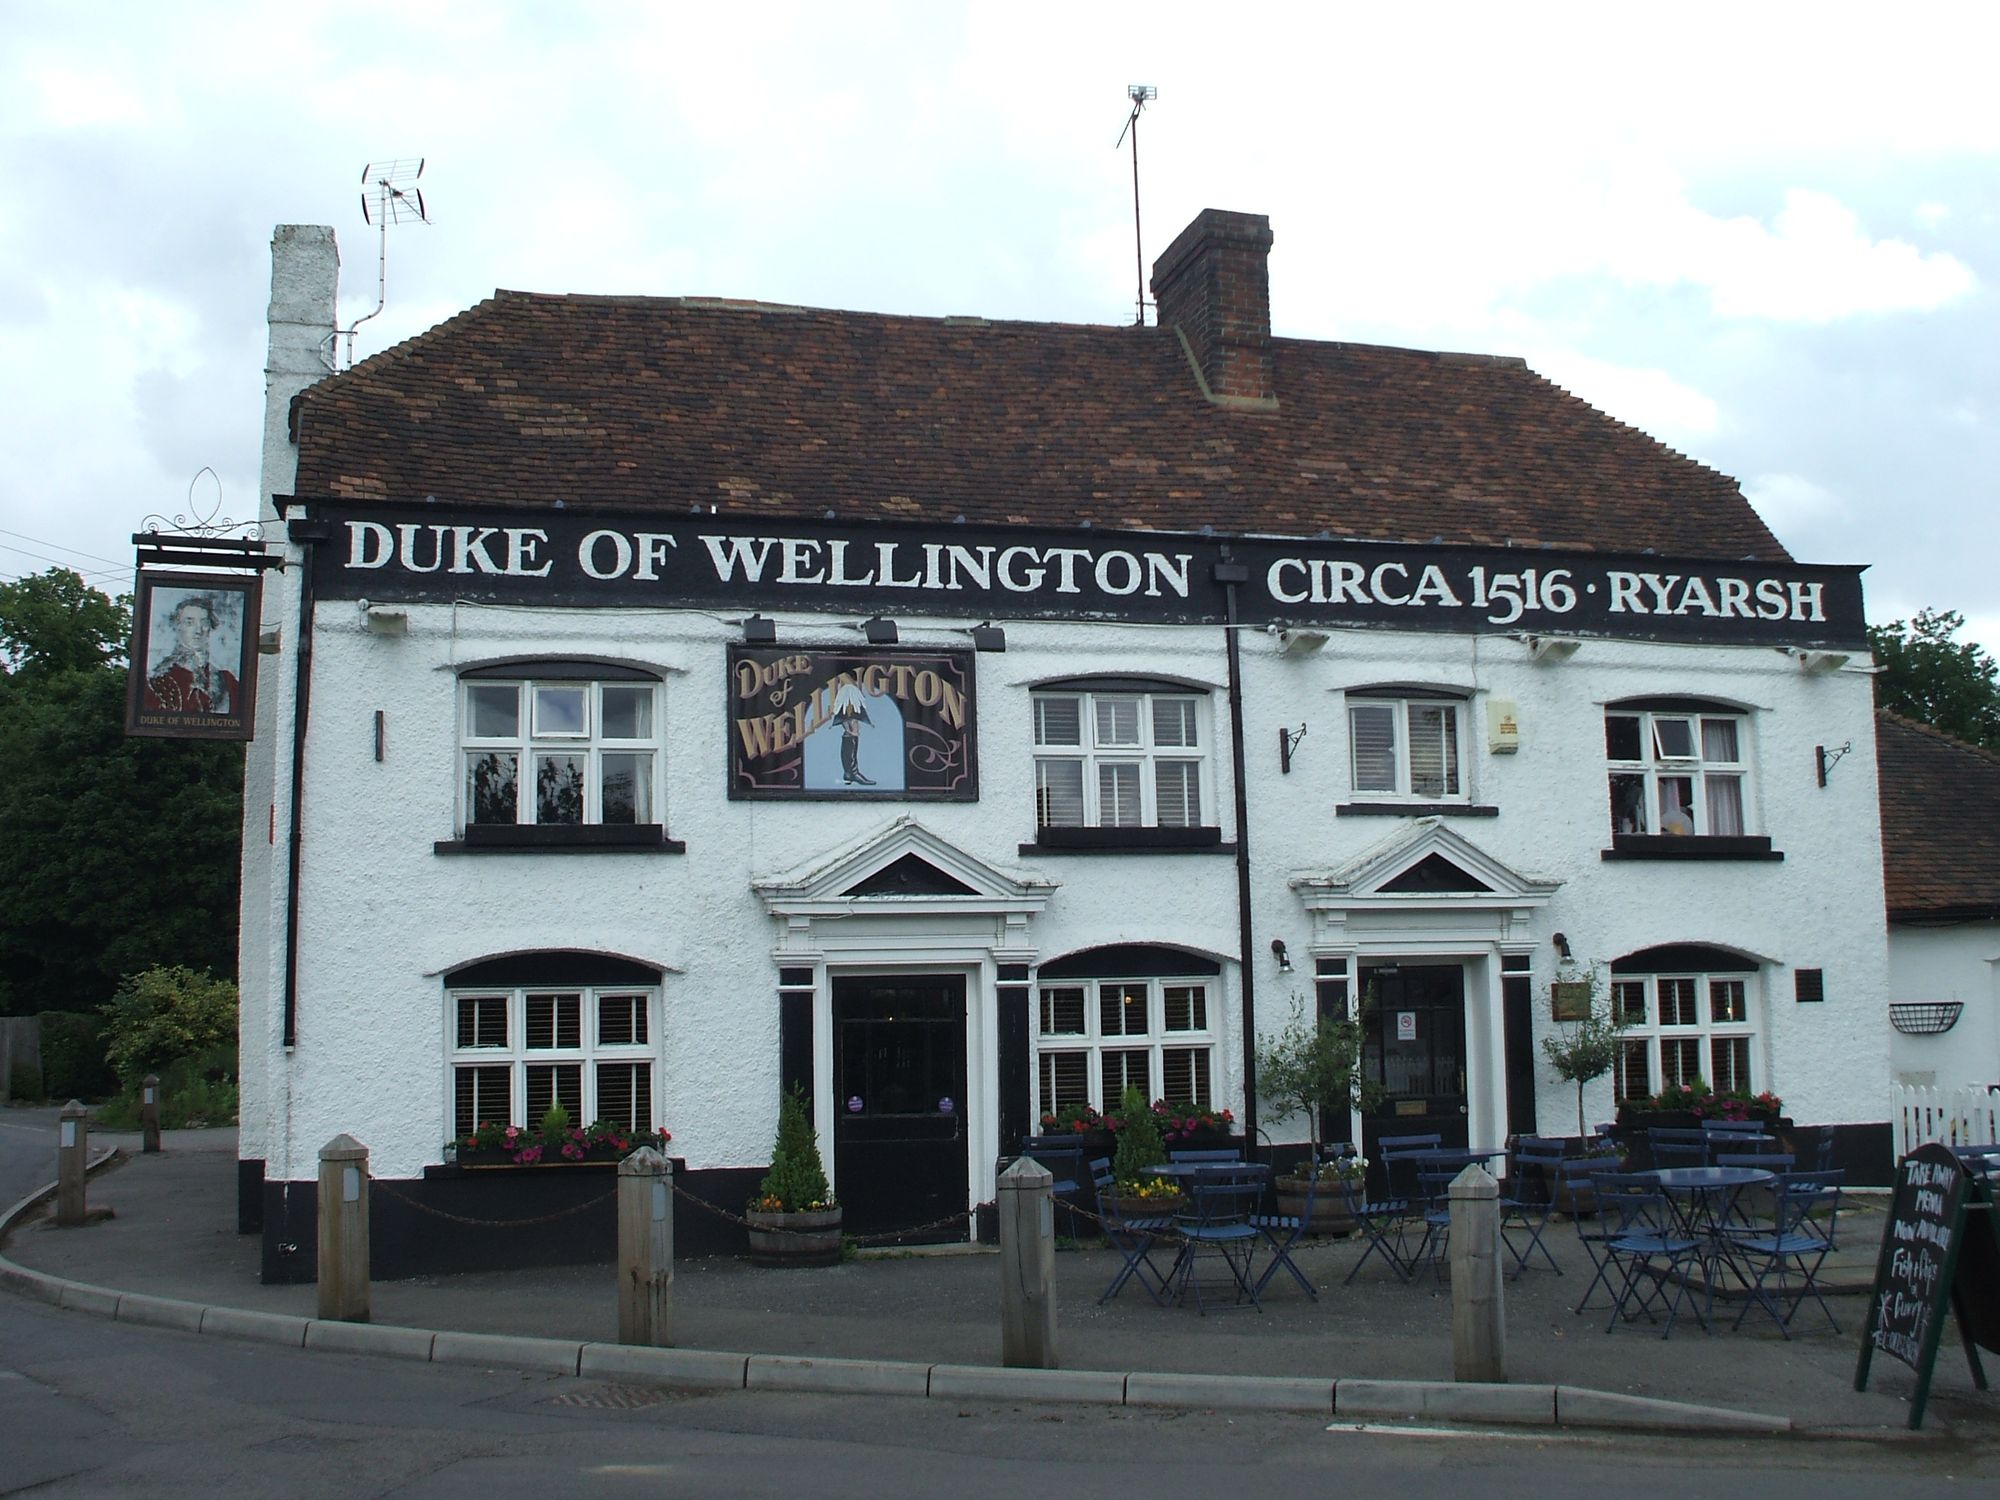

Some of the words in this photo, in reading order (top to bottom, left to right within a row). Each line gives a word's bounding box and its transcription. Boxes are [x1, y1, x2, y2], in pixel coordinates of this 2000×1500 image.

[344, 521, 552, 577] DUKE
[579, 530, 677, 580] OF
[698, 528, 1192, 597] WELLINGTON
[1268, 559, 1462, 606] CIRCA
[1468, 567, 1576, 624] 1516
[1607, 572, 1826, 621] RYARSH
[769, 678, 793, 708] of
[140, 715, 166, 725] DUKE
[168, 716, 179, 725] OF
[183, 717, 240, 728] WELLINGTON
